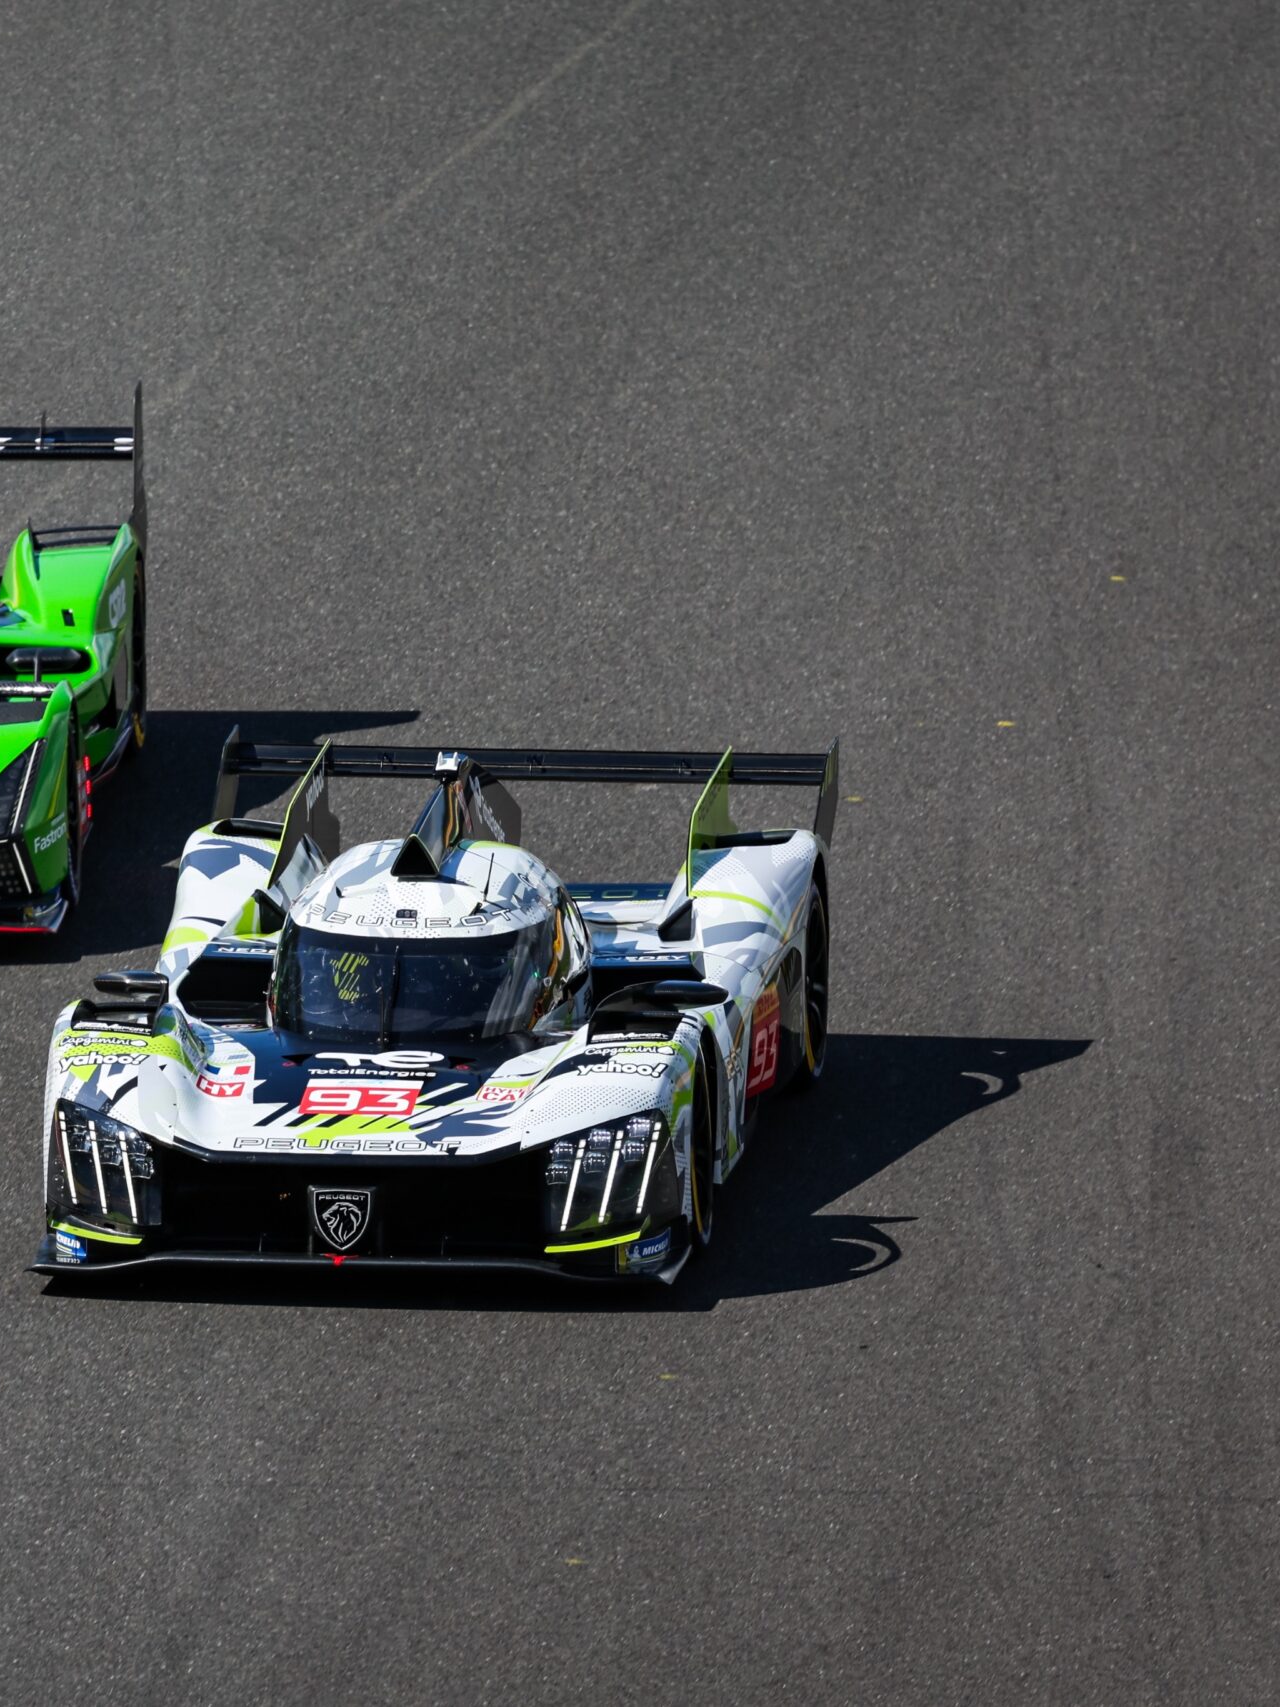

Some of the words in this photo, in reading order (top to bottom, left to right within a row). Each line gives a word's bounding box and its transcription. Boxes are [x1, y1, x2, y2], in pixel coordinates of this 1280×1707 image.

[303, 903, 511, 929] PEUGEOT
[60, 1036, 130, 1047] Capgemini
[584, 1046, 657, 1056] Capgemini
[747, 1019, 778, 1089] 93
[60, 1051, 150, 1073] yahoo!
[578, 1060, 669, 1078] yahoo!
[308, 1068, 437, 1077] TotalEnergies
[200, 1078, 243, 1096] HY
[306, 1089, 411, 1112] 93
[233, 1136, 461, 1152] PEUGEOT
